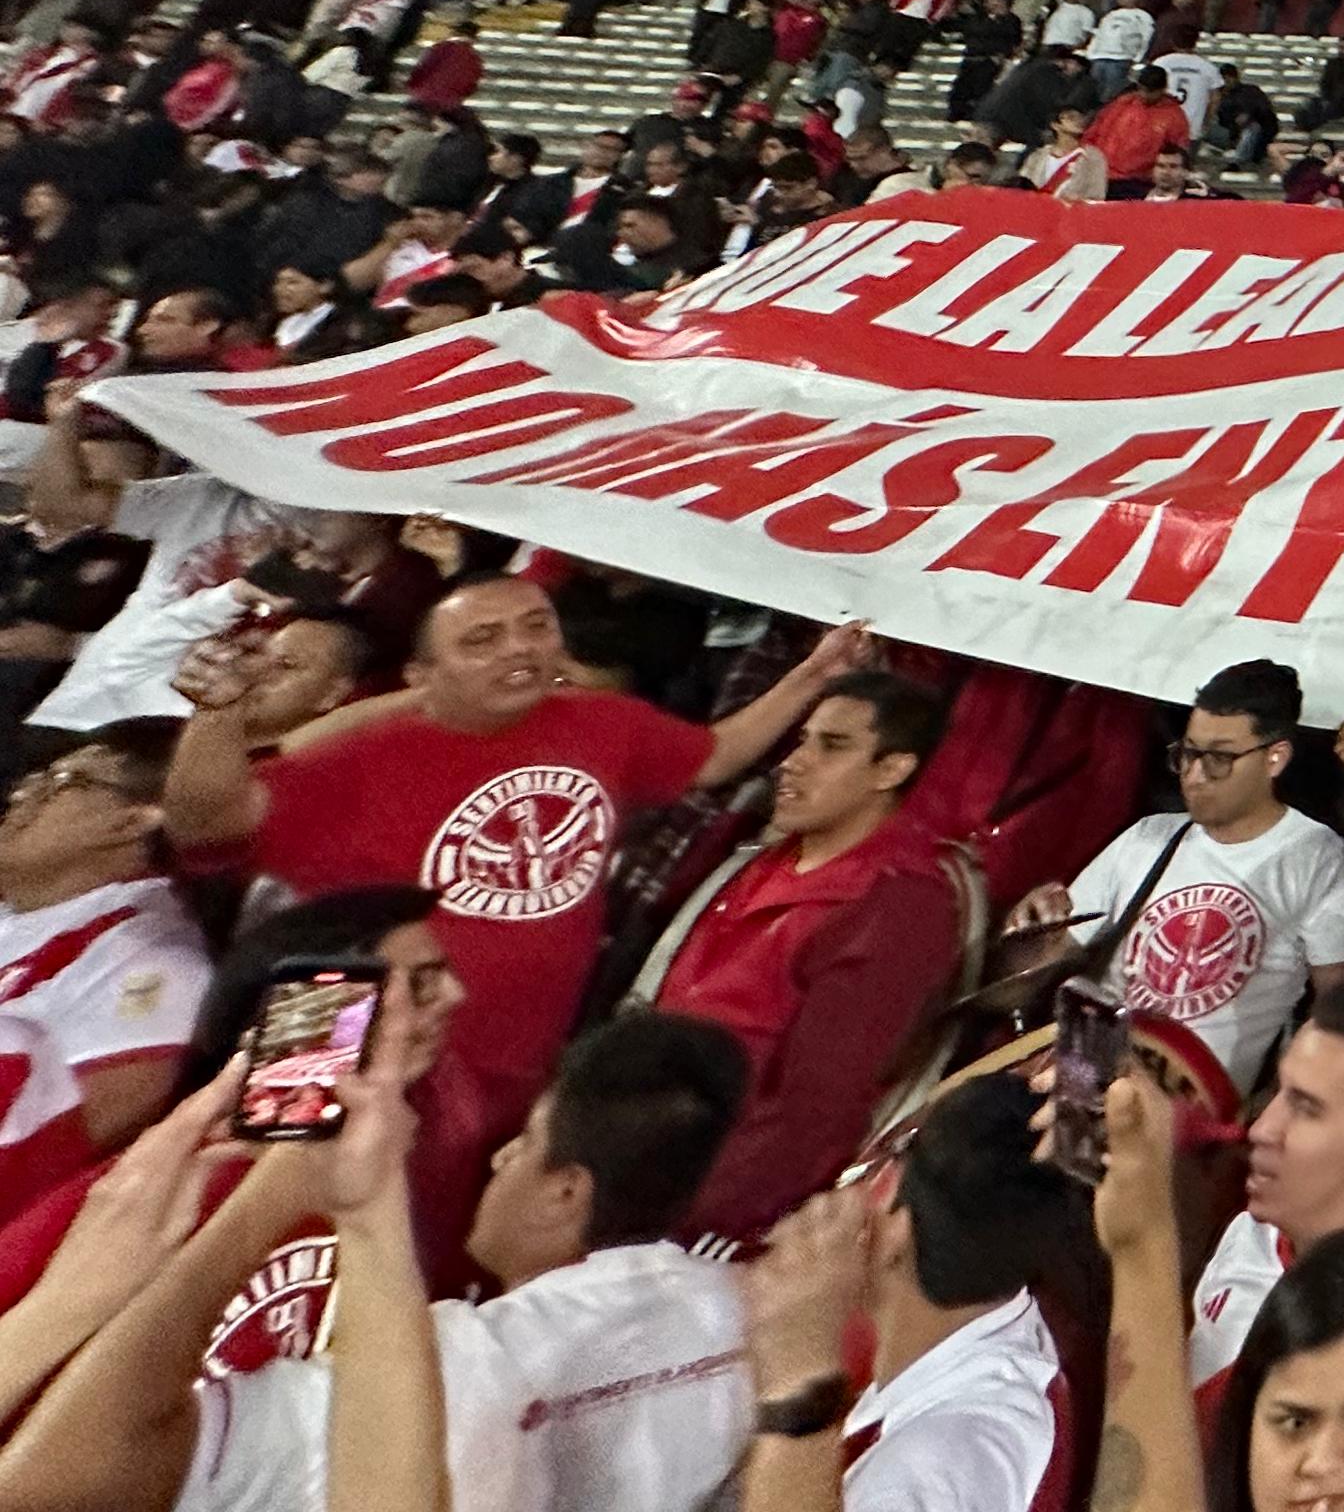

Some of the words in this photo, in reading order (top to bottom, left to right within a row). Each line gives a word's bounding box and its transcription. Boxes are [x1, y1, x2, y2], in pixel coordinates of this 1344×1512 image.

[869, 234, 1124, 355] LA
[199, 335, 635, 472] NO
[453, 404, 1055, 555] MÁS
[1144, 888, 1257, 927] SENTIMIENTO
